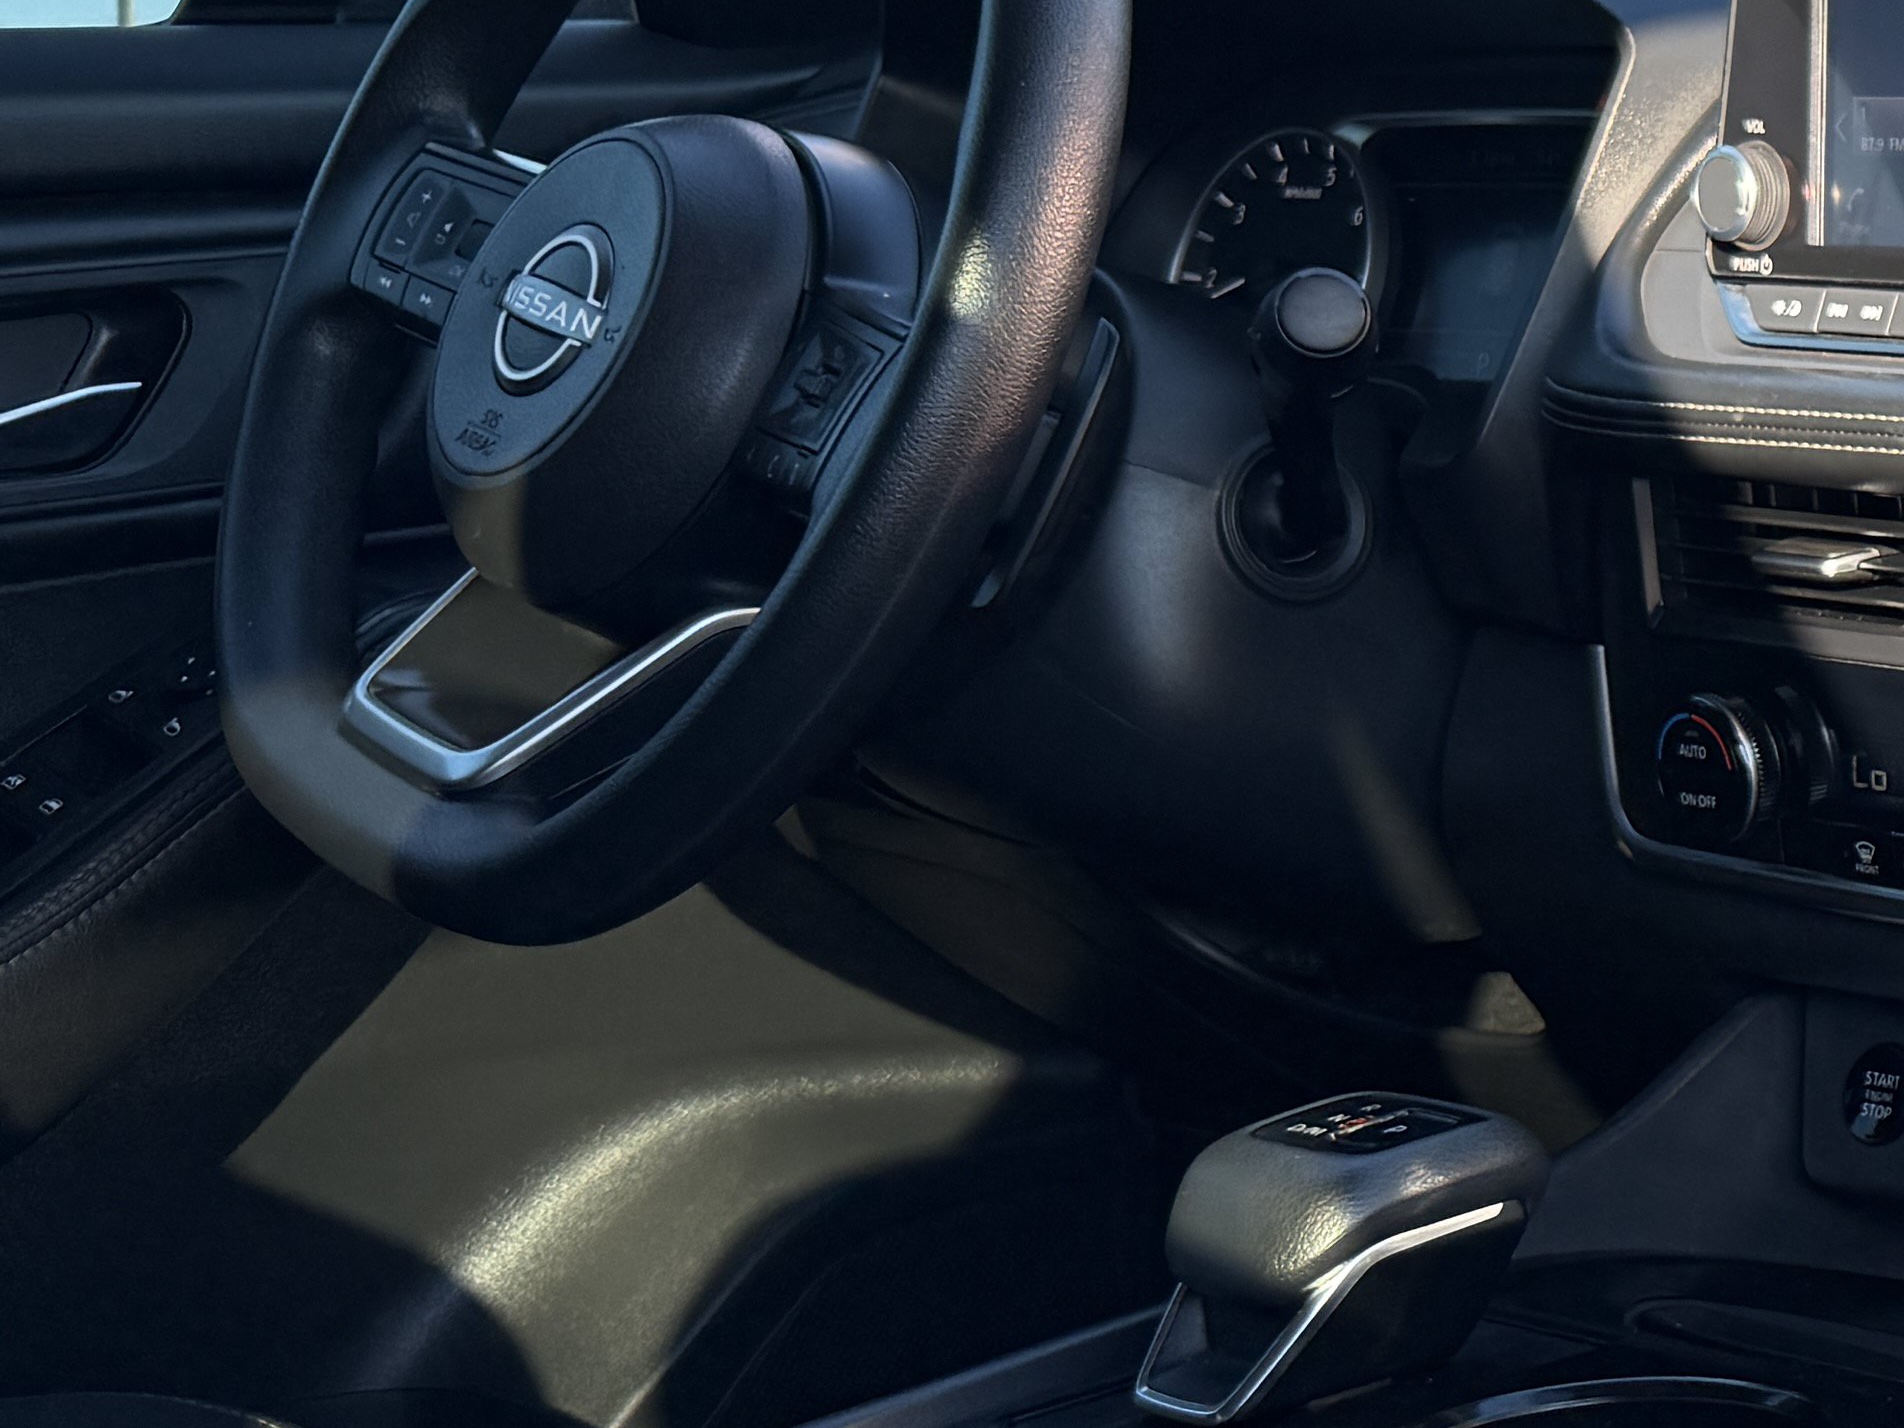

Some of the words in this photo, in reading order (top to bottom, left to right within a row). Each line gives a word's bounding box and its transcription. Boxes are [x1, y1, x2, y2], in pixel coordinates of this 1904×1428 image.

[1325, 167, 1337, 187] 5
[1352, 205, 1364, 227] 6
[1729, 257, 1760, 273] PUSH
[1679, 743, 1707, 760] AUTO
[1864, 1070, 1900, 1090] START
[1860, 1102, 1893, 1119] STOP
